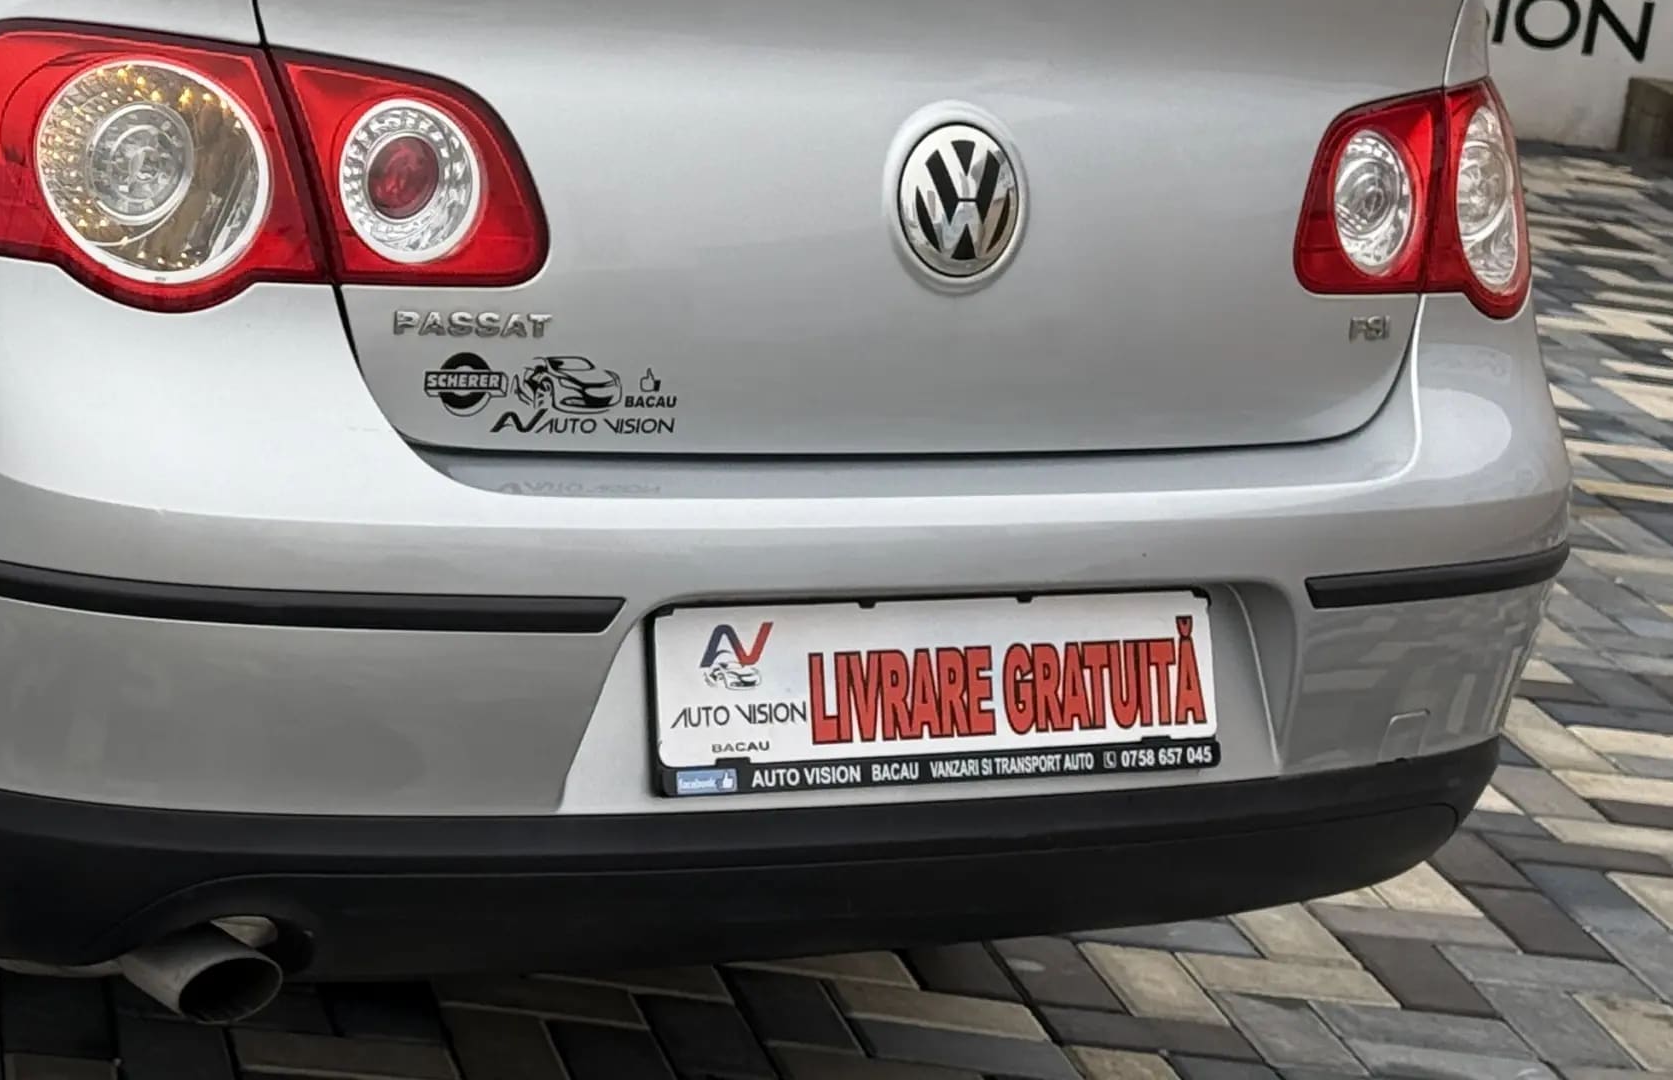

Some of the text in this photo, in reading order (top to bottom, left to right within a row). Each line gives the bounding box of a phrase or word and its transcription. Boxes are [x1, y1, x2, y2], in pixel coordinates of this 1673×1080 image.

[393, 309, 553, 339] PASSAT
[425, 373, 500, 390] SCHERER
[625, 394, 677, 409] BACAU
[534, 417, 676, 434] AUTO VISION
[808, 615, 1207, 745] LIVRARE GRATUITĂ
[670, 700, 807, 729] AUTO VISION
[711, 740, 770, 754] BACAU
[751, 745, 1213, 788] AUTO VISION BACAU VANZARI SI TRANSPORT AUTO 0758 657 045
